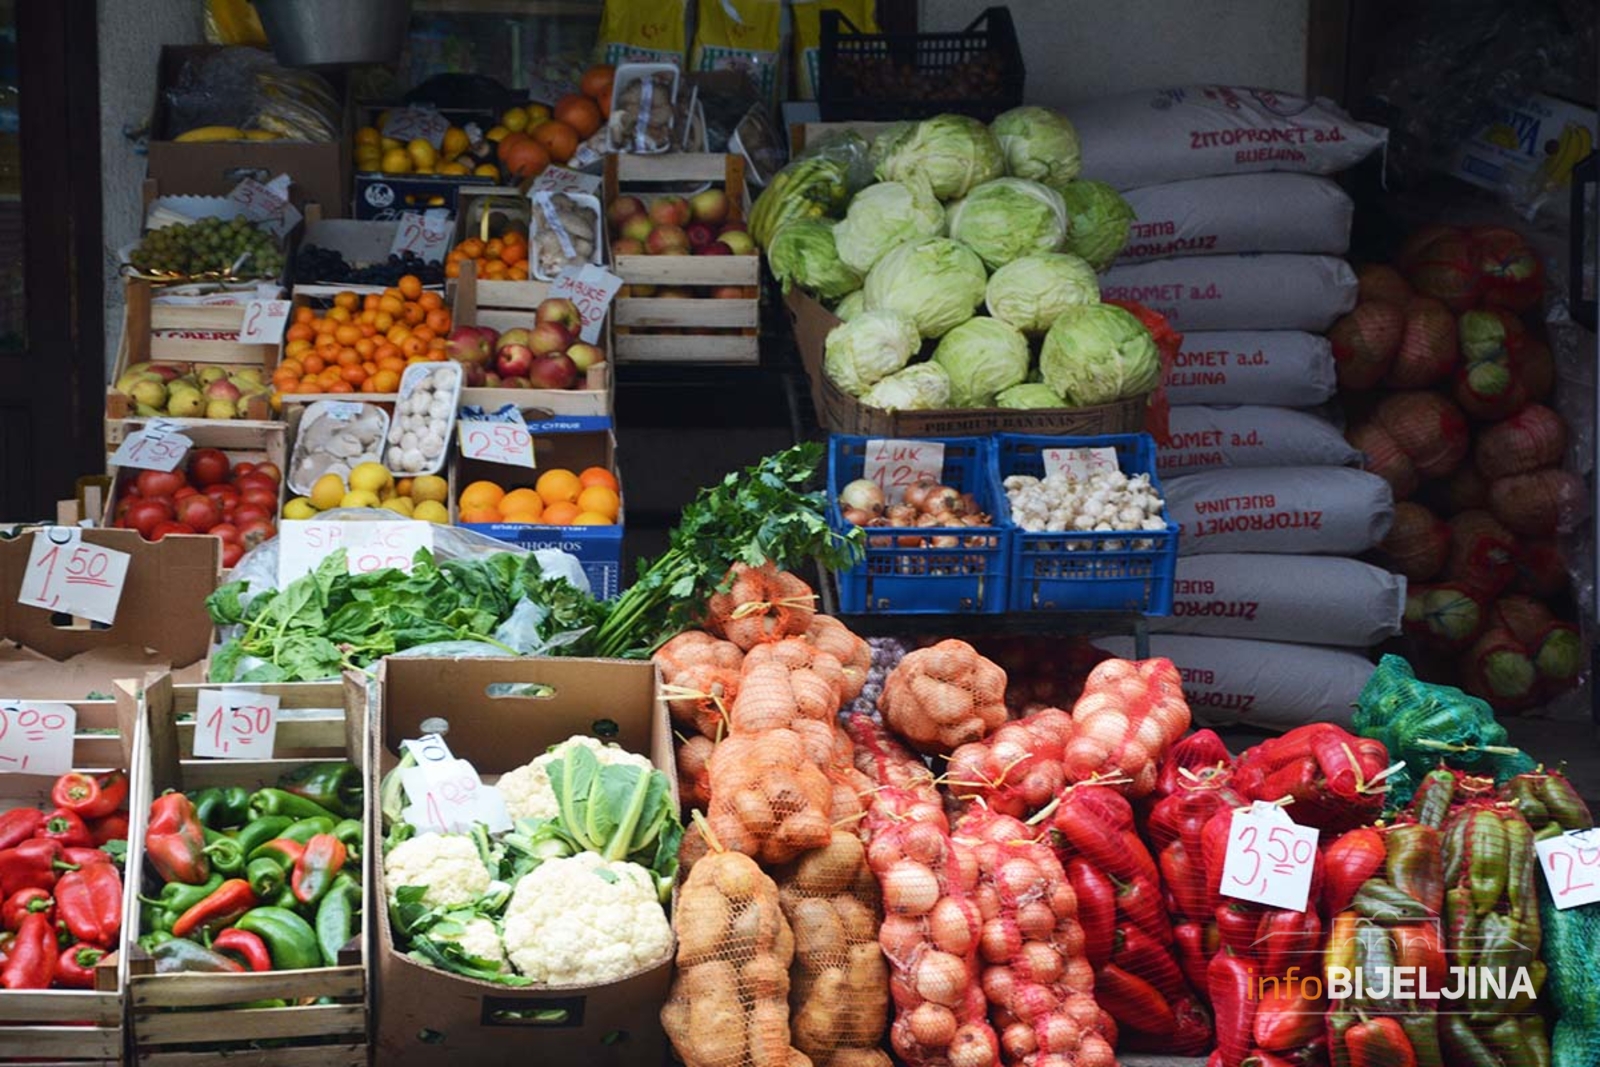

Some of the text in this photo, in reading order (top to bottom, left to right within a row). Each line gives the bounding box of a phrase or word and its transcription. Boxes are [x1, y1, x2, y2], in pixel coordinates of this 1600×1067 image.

[1313, 126, 1346, 142] a.d.
[1173, 350, 1269, 367] OMET a.d.
[924, 416, 1075, 433] PREMIUM BANANAS
[1231, 430, 1263, 446] a.d.
[1172, 601, 1259, 621] ŽITOPRO
[206, 705, 271, 753] 1,50
[1231, 826, 1313, 897] 3,50
